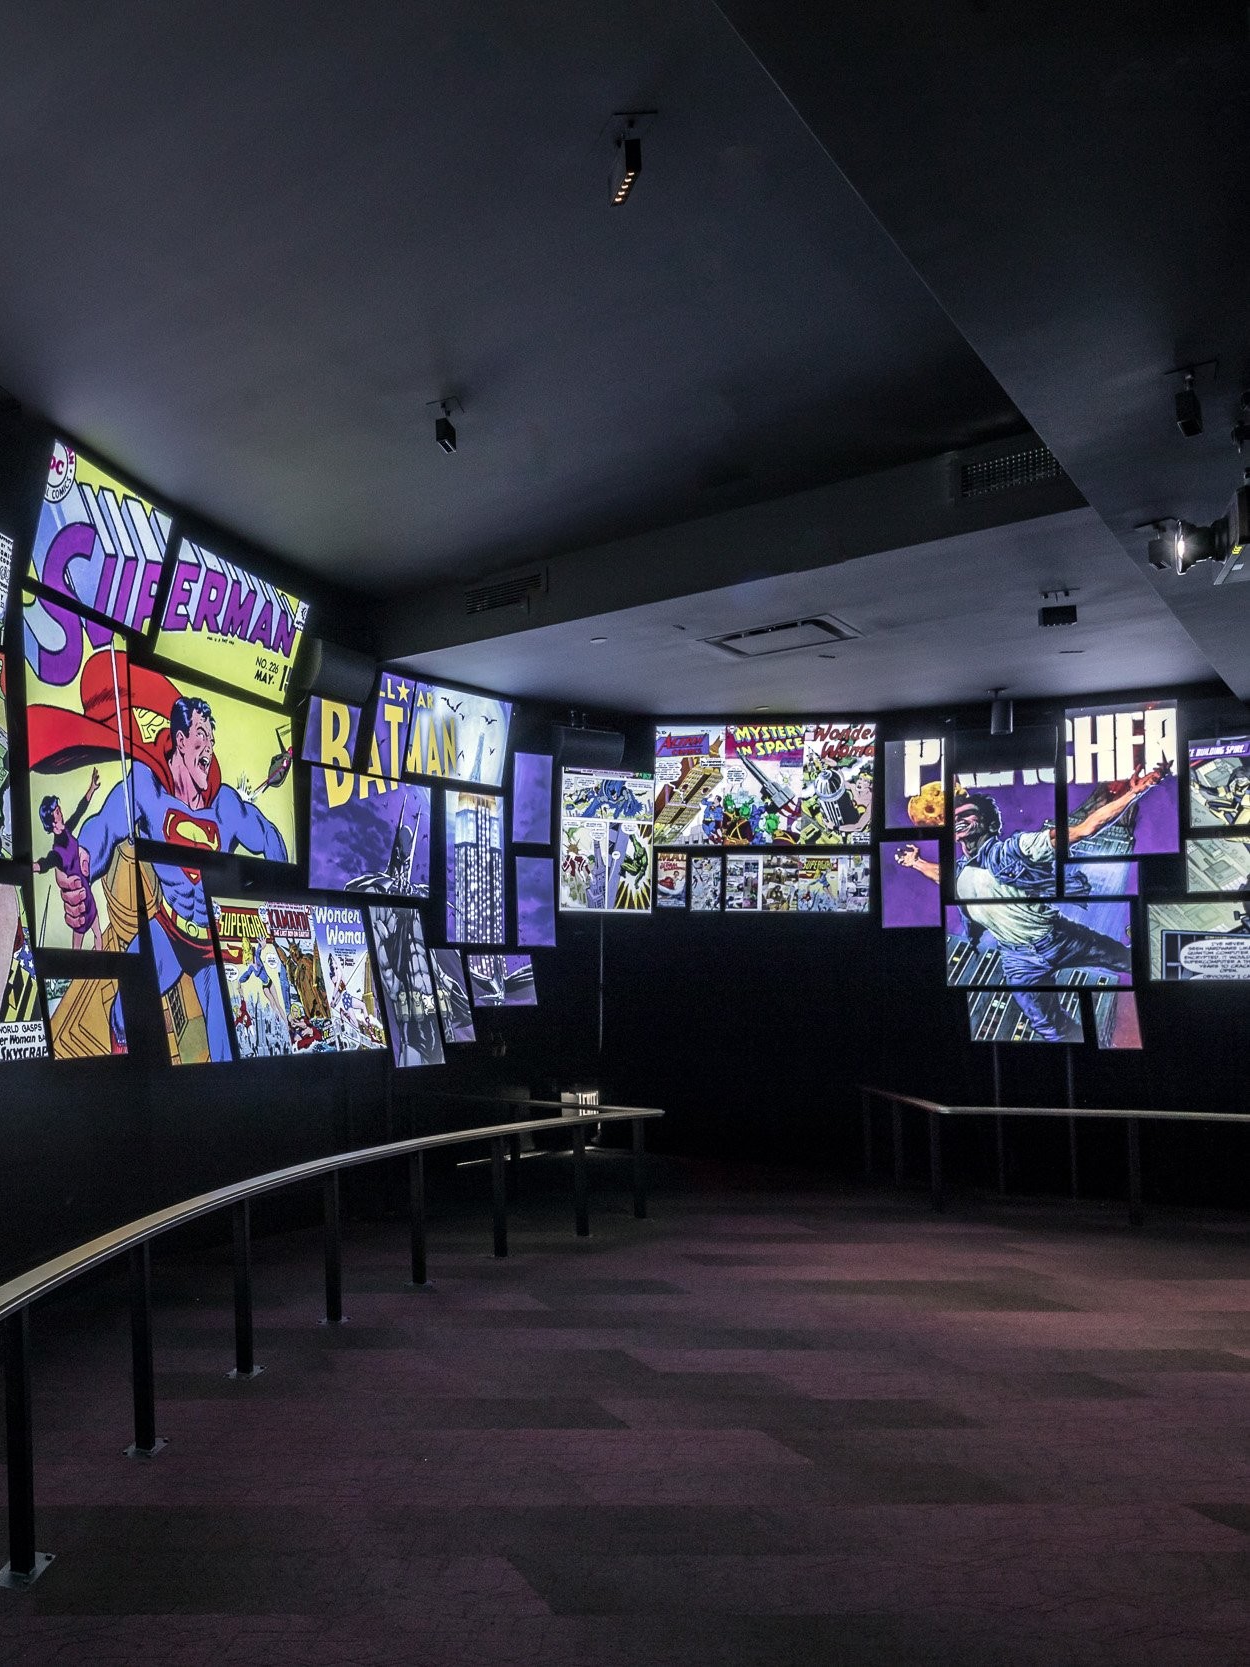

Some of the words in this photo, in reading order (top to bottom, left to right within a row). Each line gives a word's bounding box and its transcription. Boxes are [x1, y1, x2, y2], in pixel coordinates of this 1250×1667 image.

[51, 476, 71, 500] COMICS
[255, 656, 268, 670] NO.
[269, 662, 279, 675] 226
[734, 725, 804, 741] MYSTERY
[321, 698, 457, 809] BATMAN
[736, 746, 752, 756] IN
[755, 737, 804, 757] SPACE
[314, 905, 362, 924] Wonder
[21, 1023, 42, 1032] GASPS
[10, 1034, 36, 1045] Woman
